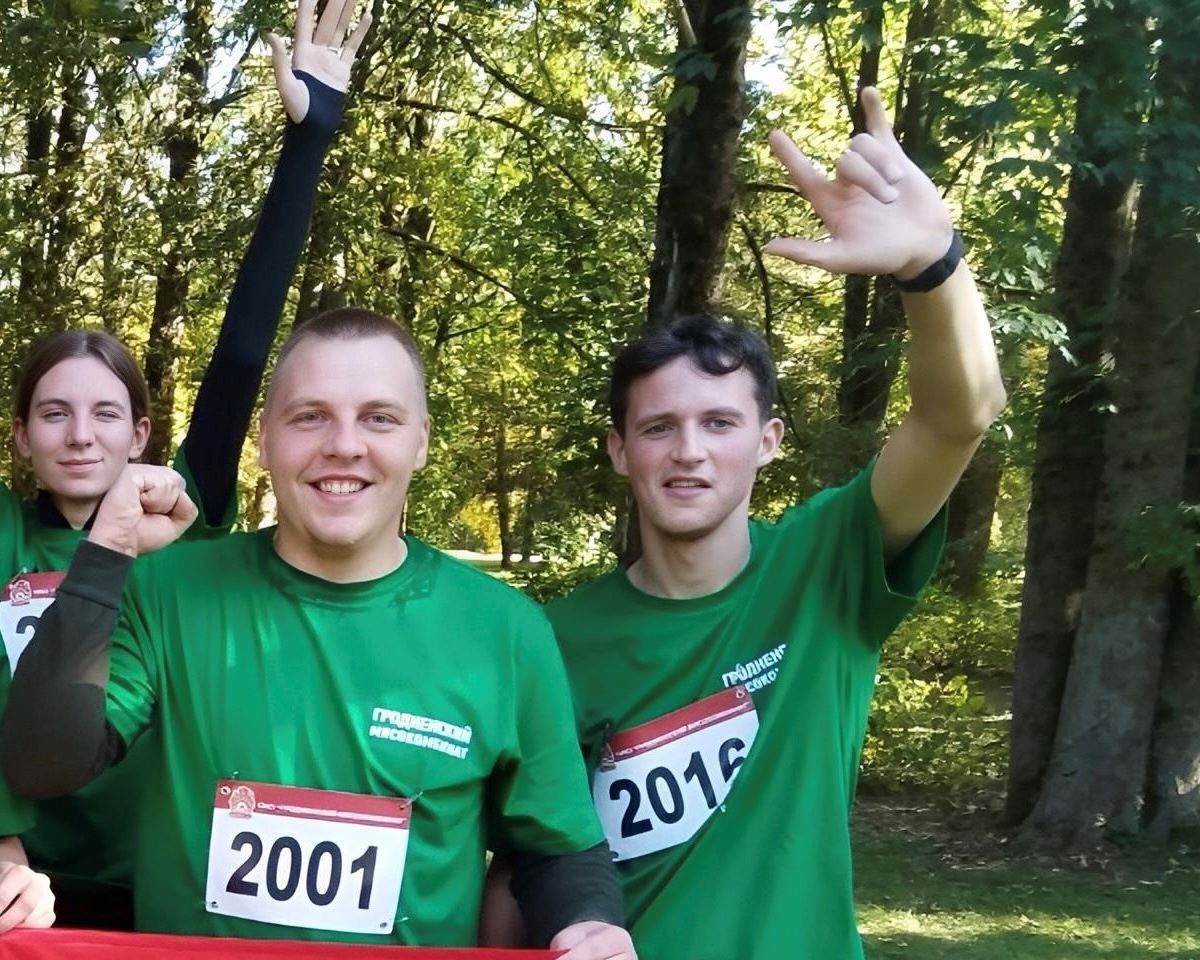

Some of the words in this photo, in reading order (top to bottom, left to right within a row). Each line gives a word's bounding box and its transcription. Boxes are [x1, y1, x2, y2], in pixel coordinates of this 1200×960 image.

[372, 707, 472, 744] ГРОДНЕНСКИЙ
[609, 737, 746, 839] 2016
[226, 831, 378, 910] 2001
